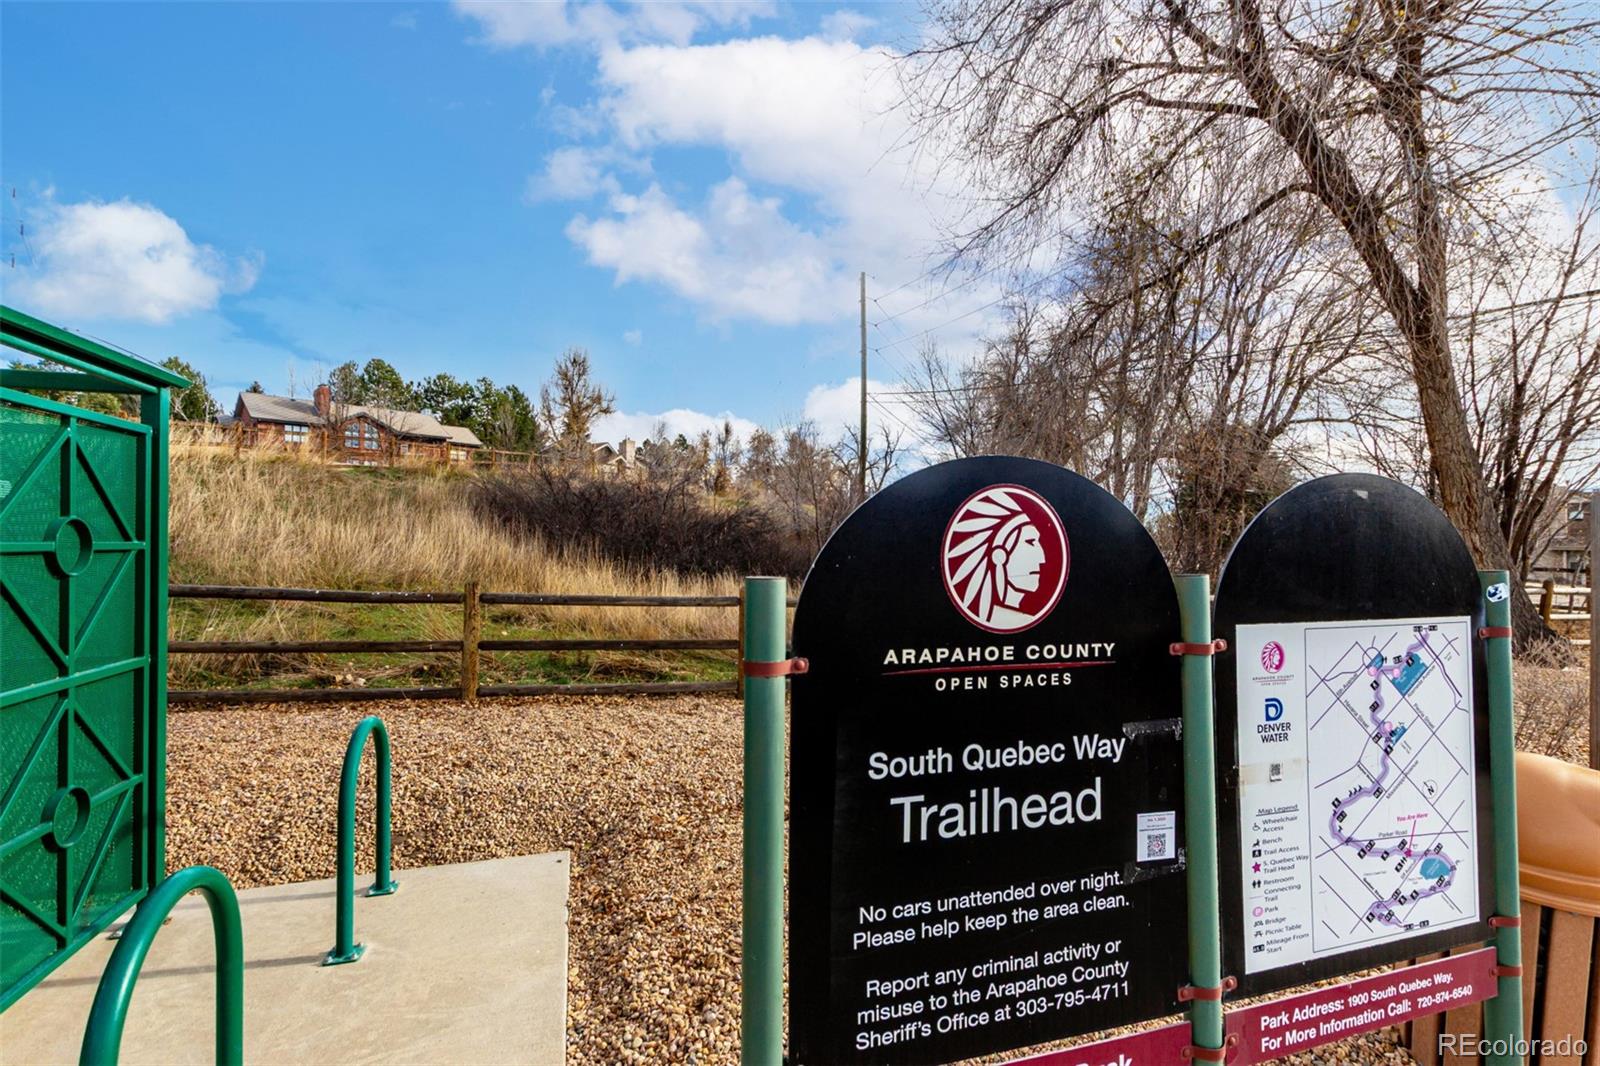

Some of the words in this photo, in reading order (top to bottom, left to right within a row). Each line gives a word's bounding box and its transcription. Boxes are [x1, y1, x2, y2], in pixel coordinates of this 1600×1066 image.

[884, 646, 1014, 664] ARAPAHOE
[1026, 643, 1115, 659] COUNTY
[936, 676, 987, 691] OPEN
[1000, 673, 1072, 688] SPACES
[1258, 722, 1291, 733] DENVER
[1261, 733, 1288, 743] WATER
[868, 748, 952, 779] South
[962, 741, 1065, 770] Quebec
[1073, 734, 1126, 763] Way
[890, 777, 1102, 843] Trailhead
[1274, 804, 1298, 813] Legend
[1262, 815, 1297, 824] Wheelchair
[1262, 837, 1282, 845] Bench
[1270, 856, 1294, 866] Quebec
[1264, 876, 1294, 885] Restroom
[859, 906, 887, 924] No
[892, 901, 932, 918] cars
[937, 883, 1035, 912] unattended
[1040, 878, 1076, 896] over
[1080, 871, 1123, 893] night.
[1264, 884, 1301, 895] Connecting
[853, 926, 916, 950] Please
[921, 919, 959, 940] help
[965, 912, 1007, 932] keep
[1012, 905, 1039, 923] the
[1044, 898, 1078, 917] area
[1083, 894, 1129, 913] clean.
[1265, 917, 1286, 926] Bridge
[1266, 928, 1283, 936] Picnic
[1285, 923, 1302, 932] Table
[1266, 935, 1291, 946] Mileage
[1293, 932, 1309, 940] From
[866, 972, 929, 997] Report
[935, 969, 967, 987] any
[972, 952, 1038, 978] criminal
[1044, 942, 1100, 966] activity
[1105, 938, 1121, 953] or
[857, 1001, 924, 1025] misuse
[929, 994, 947, 1011] to
[953, 989, 980, 1007] the
[986, 973, 1067, 999] Arapahoe
[1072, 962, 1129, 984] County
[937, 1011, 989, 1033] Office
[995, 1005, 1011, 1021] at
[1016, 981, 1128, 1017] 303-795-4711
[1261, 1013, 1289, 1031] Park
[1293, 999, 1344, 1023] Address:
[1348, 994, 1368, 1008] 1900
[1370, 987, 1397, 1003] South
[1399, 979, 1432, 996] Quebec
[1433, 973, 1453, 989] Way.
[1261, 1036, 1282, 1052] For
[1285, 1026, 1316, 1045] More
[1320, 1007, 1385, 1034] Information
[1388, 1001, 1411, 1018] Call:
[1417, 985, 1472, 1008] 720-874-6540
